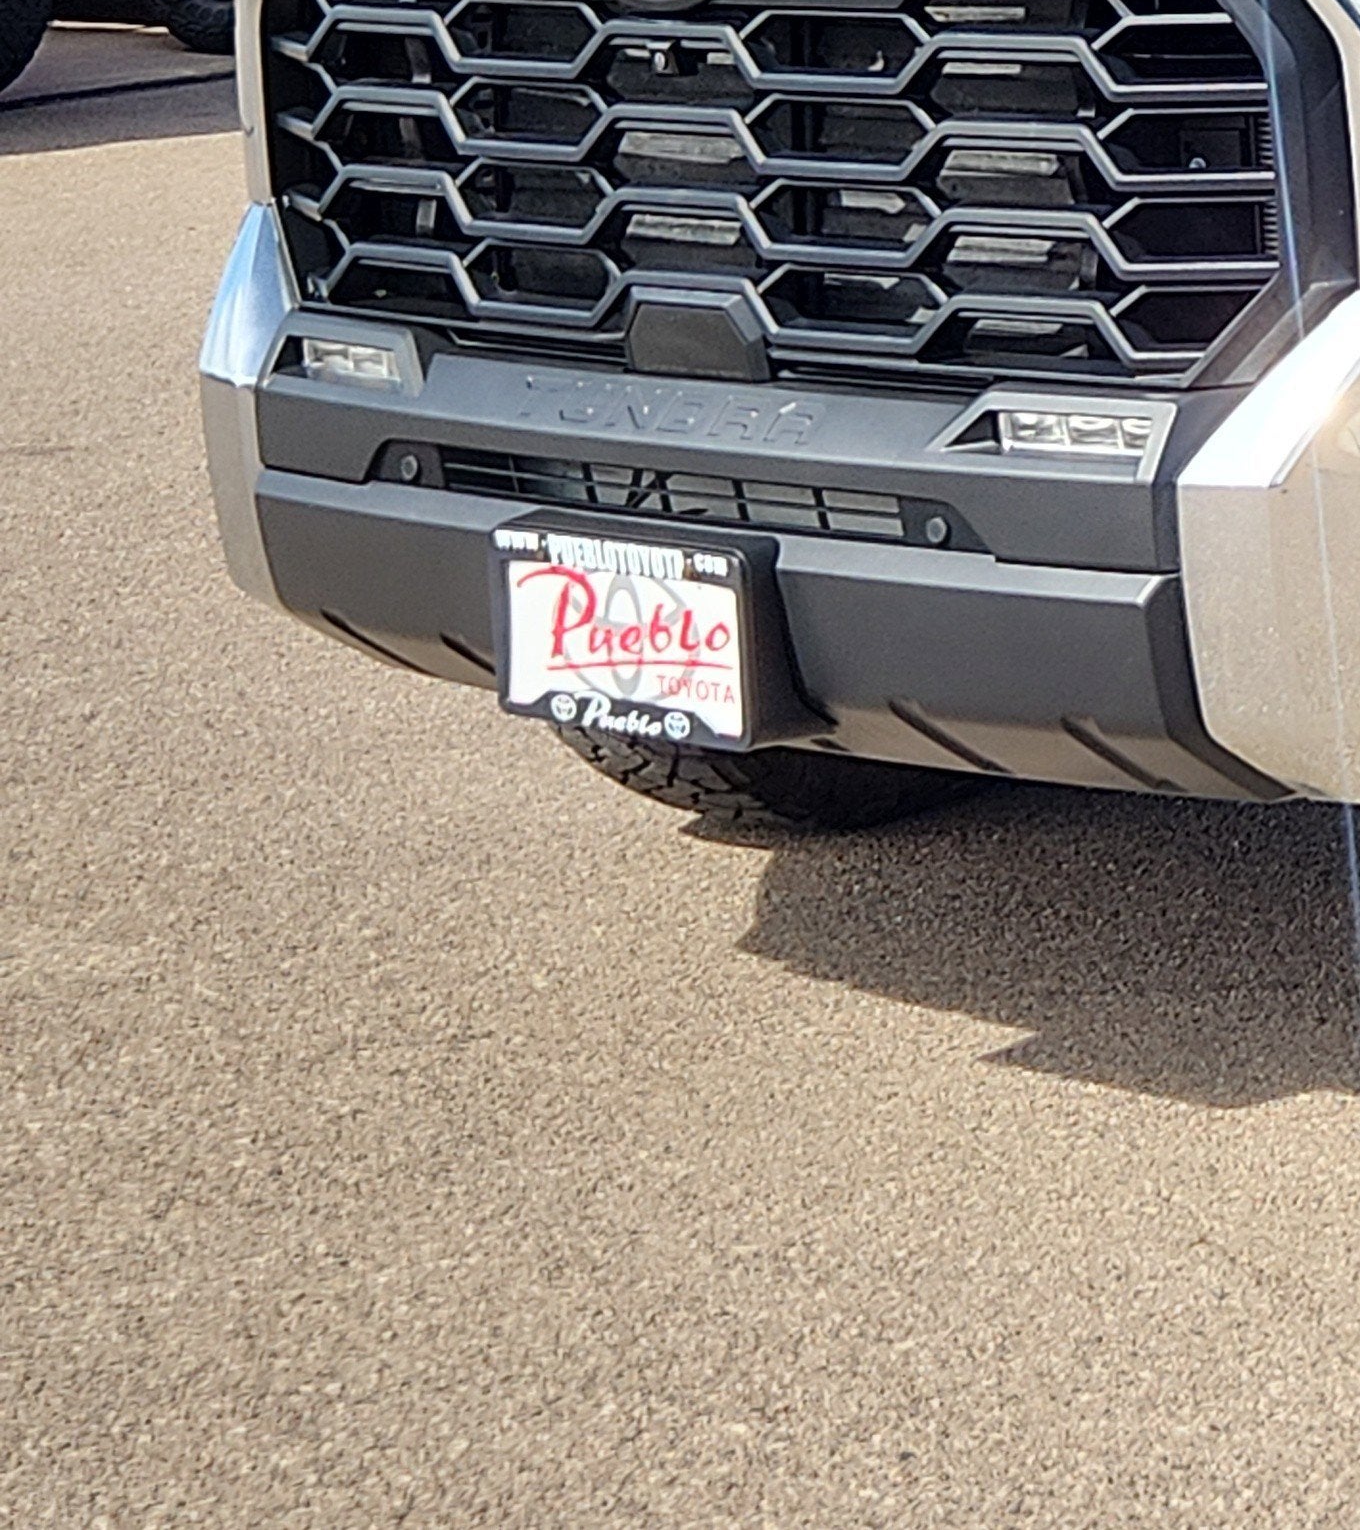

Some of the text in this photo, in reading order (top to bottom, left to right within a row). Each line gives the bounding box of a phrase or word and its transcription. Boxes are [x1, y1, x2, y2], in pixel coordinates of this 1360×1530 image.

[517, 565, 731, 658] Pueblo
[574, 689, 662, 736] Pueblo
[656, 674, 736, 704] TOYOTA
